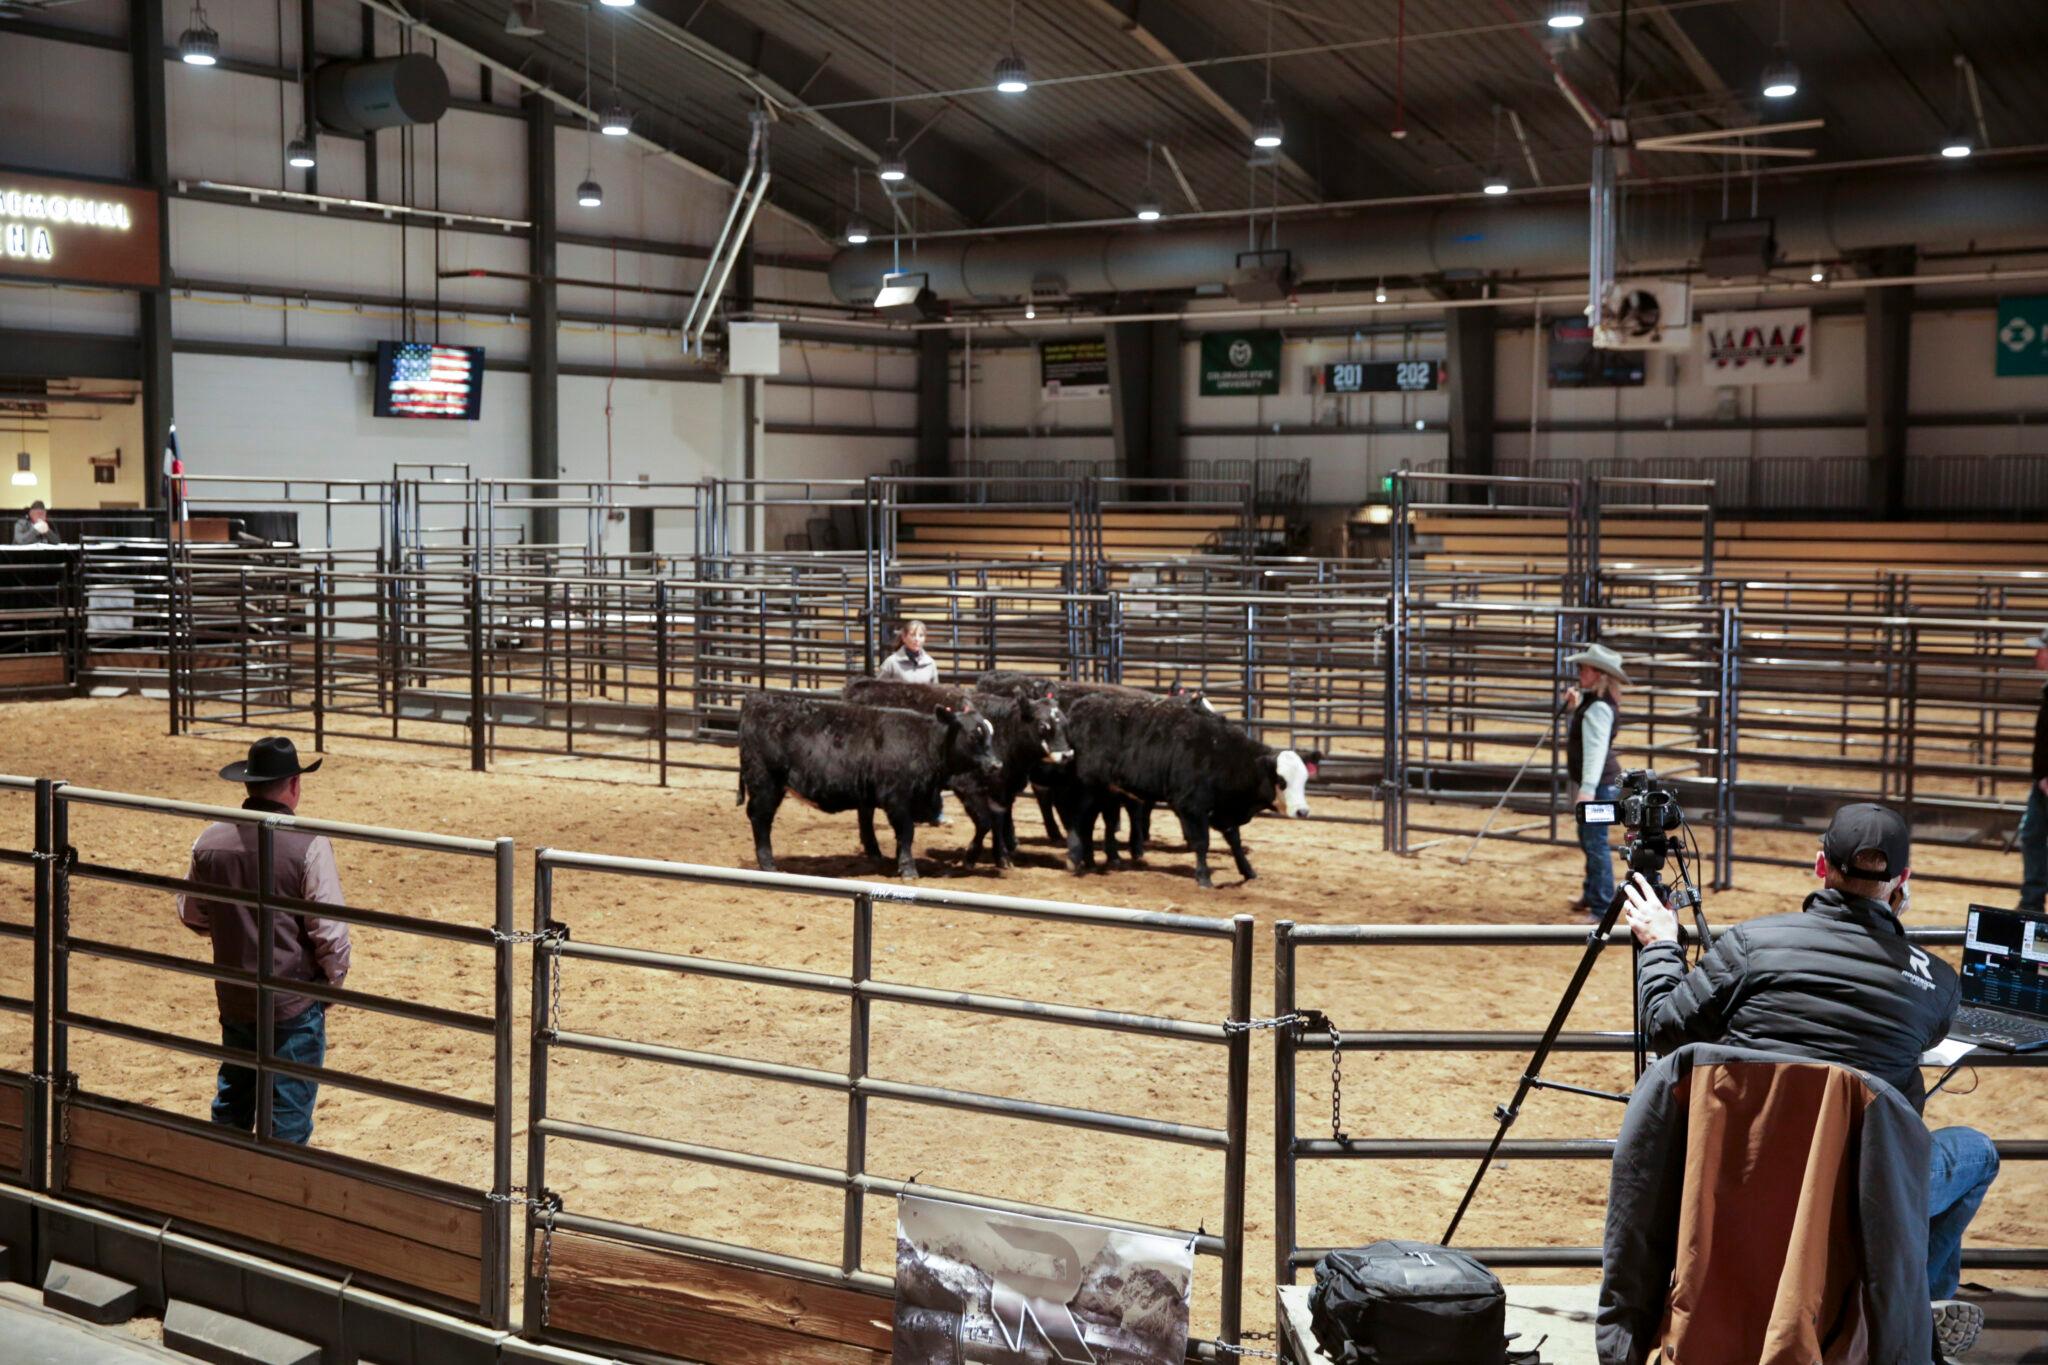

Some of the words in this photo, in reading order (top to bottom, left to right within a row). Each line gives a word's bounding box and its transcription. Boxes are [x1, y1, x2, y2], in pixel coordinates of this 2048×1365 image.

[0, 190, 131, 229] EMORIAL
[0, 224, 53, 259] NA
[1206, 370, 1248, 381] COLORADO
[1249, 369, 1274, 379] STATE
[1216, 379, 1262, 389] UNIVERSITY
[1333, 363, 1362, 386] 201
[1396, 361, 1430, 385] 202
